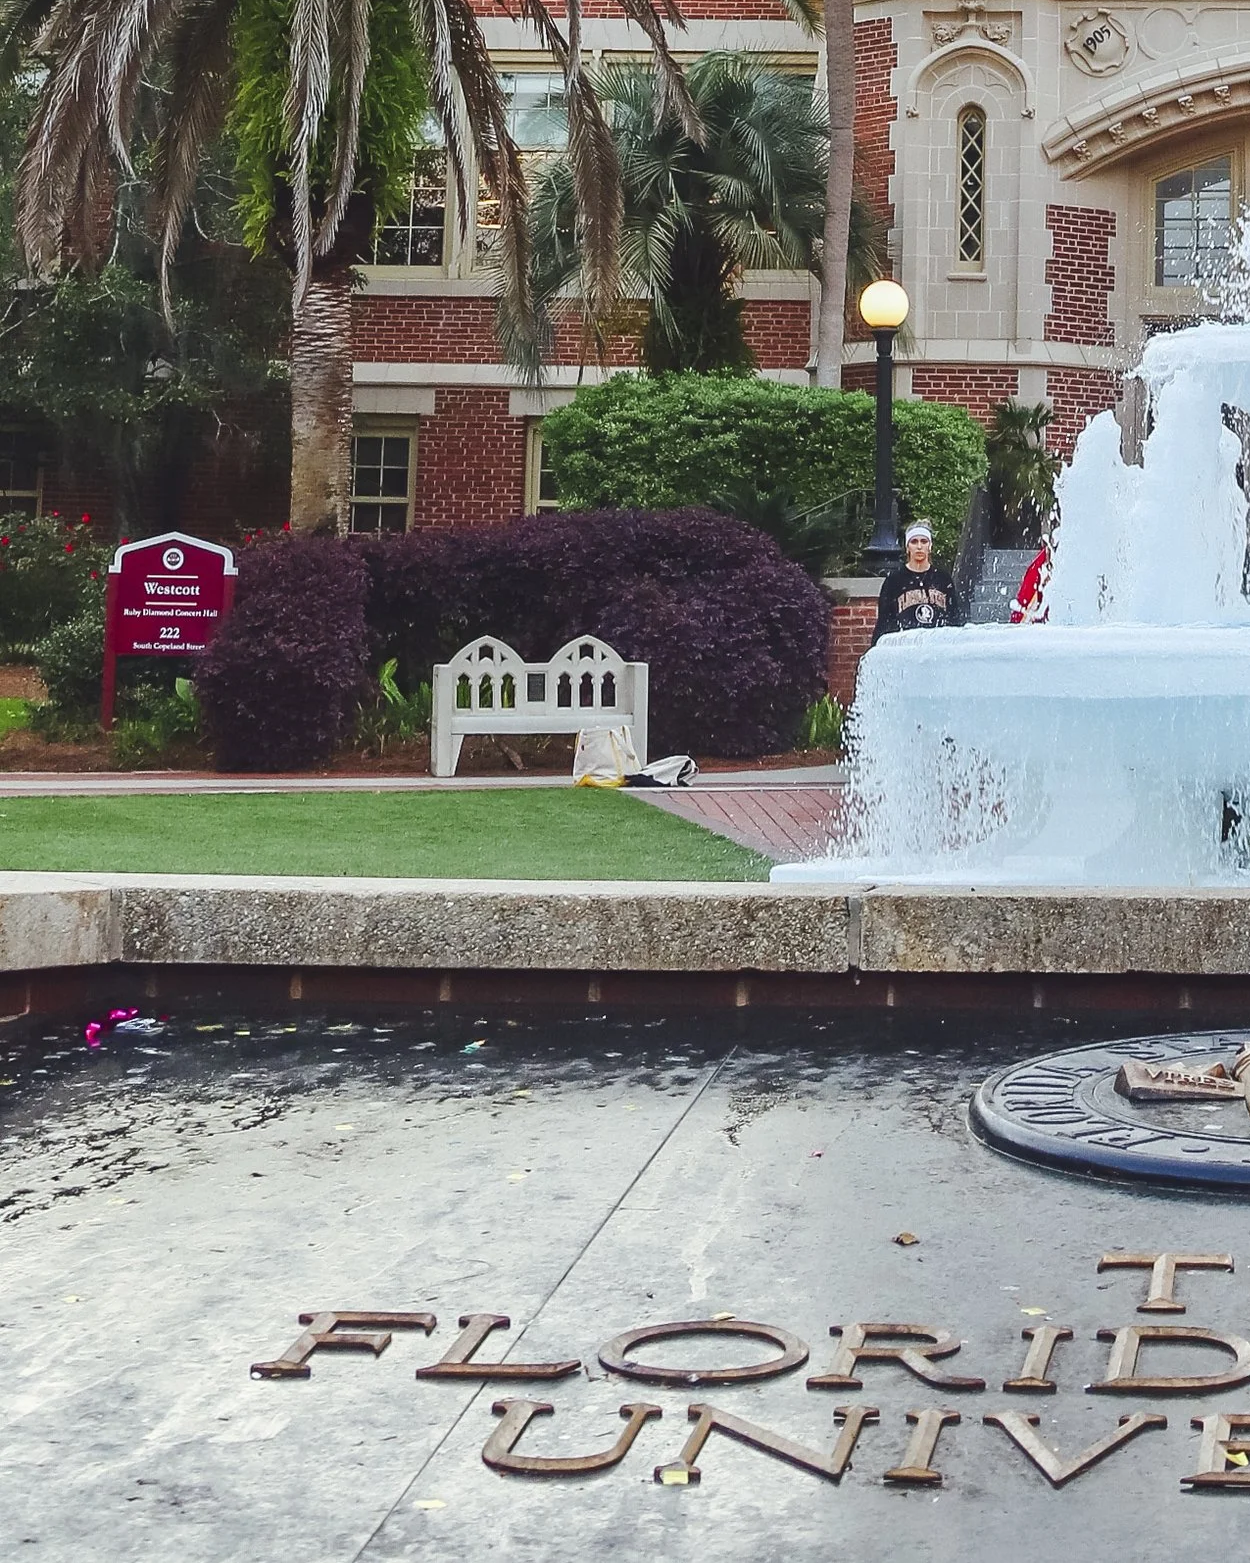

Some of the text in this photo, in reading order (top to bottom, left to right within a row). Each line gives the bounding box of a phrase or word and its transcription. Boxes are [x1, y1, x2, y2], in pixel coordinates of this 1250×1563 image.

[1082, 24, 1111, 57] 1905
[144, 581, 200, 596] Westcott
[123, 608, 218, 618] Ruby Diamond Concert Hall
[159, 626, 180, 639] 222
[132, 641, 152, 650] South
[153, 642, 185, 652] Copeland
[1145, 1067, 1236, 1090] VIRES
